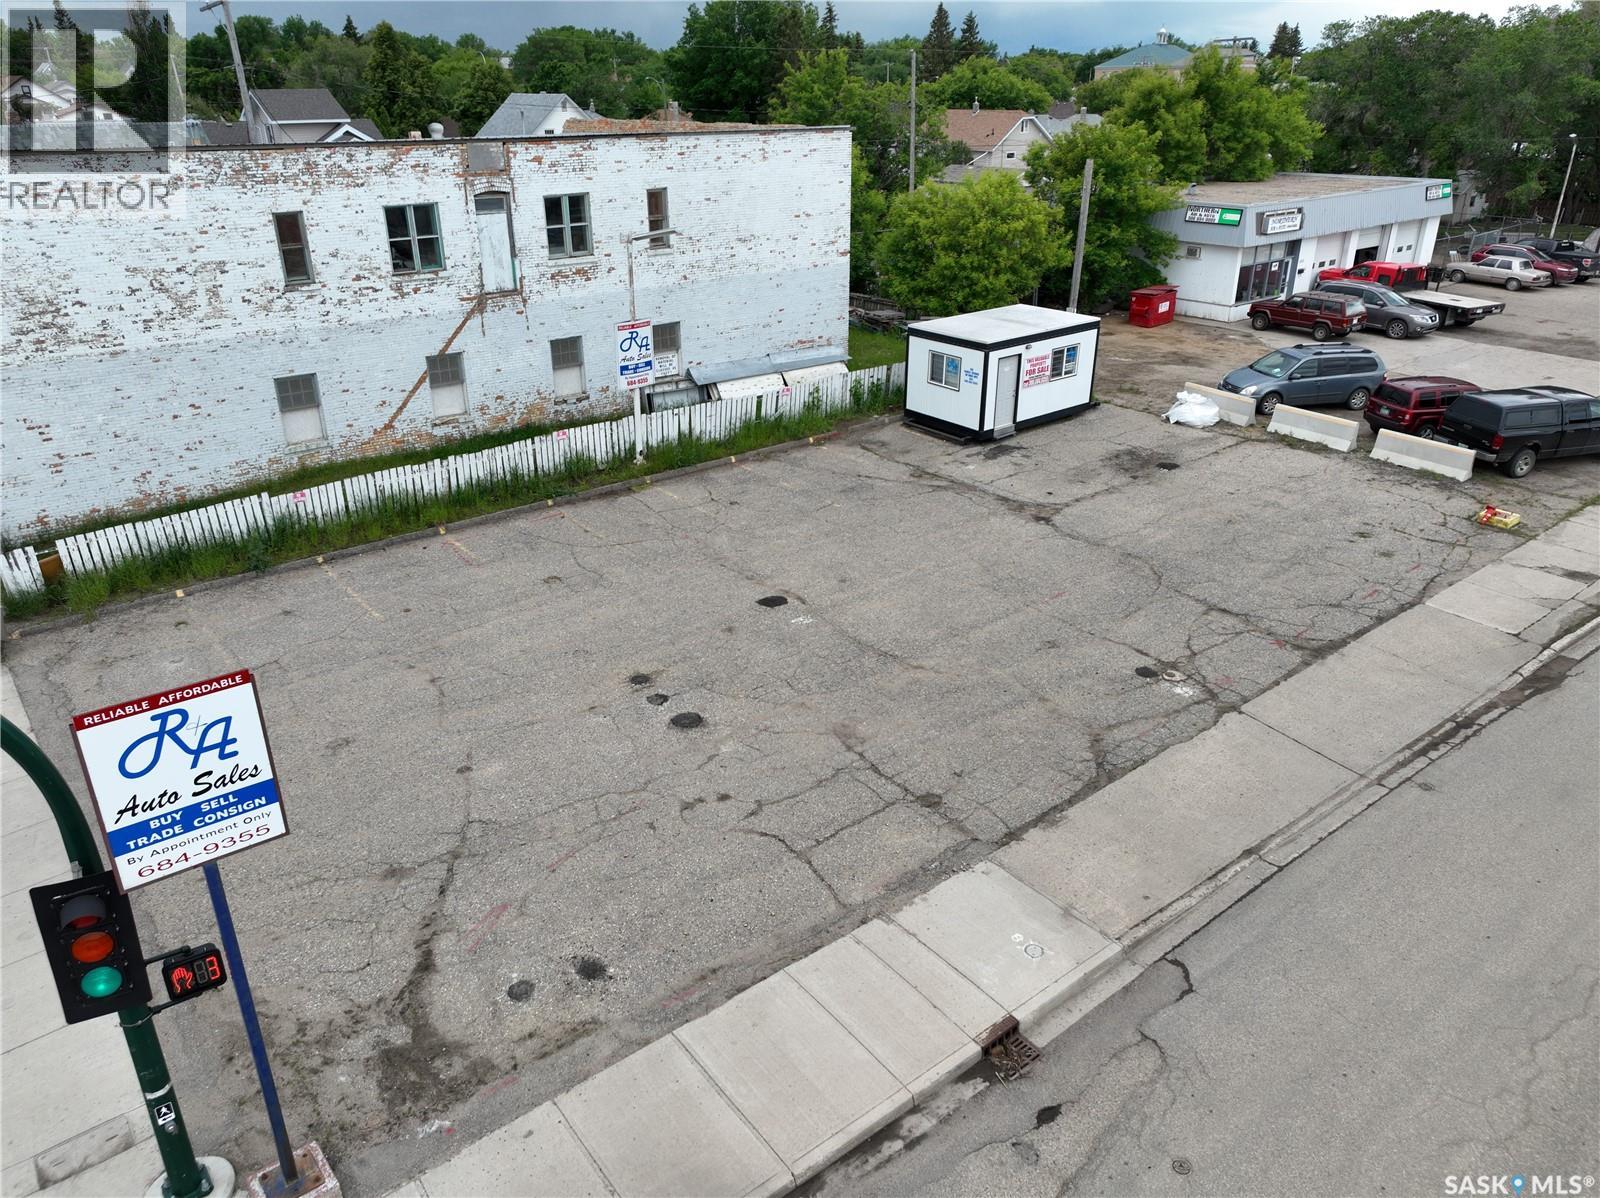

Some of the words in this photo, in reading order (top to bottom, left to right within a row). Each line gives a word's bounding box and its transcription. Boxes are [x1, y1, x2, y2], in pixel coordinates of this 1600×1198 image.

[1025, 367, 1036, 377] FOR
[1037, 364, 1050, 374] SALE
[83, 701, 150, 726] RELIABLE
[158, 674, 243, 705] AFFORDABLE
[114, 789, 183, 824] Auto
[191, 763, 262, 797] Sales
[150, 811, 183, 829] BUY
[200, 794, 238, 812] SELL
[126, 824, 184, 850] TRADE
[193, 796, 267, 827] CONSIGN
[127, 855, 144, 866] By
[150, 822, 238, 858] Appointment
[243, 811, 272, 825] Only
[137, 824, 271, 878] 684-9355
